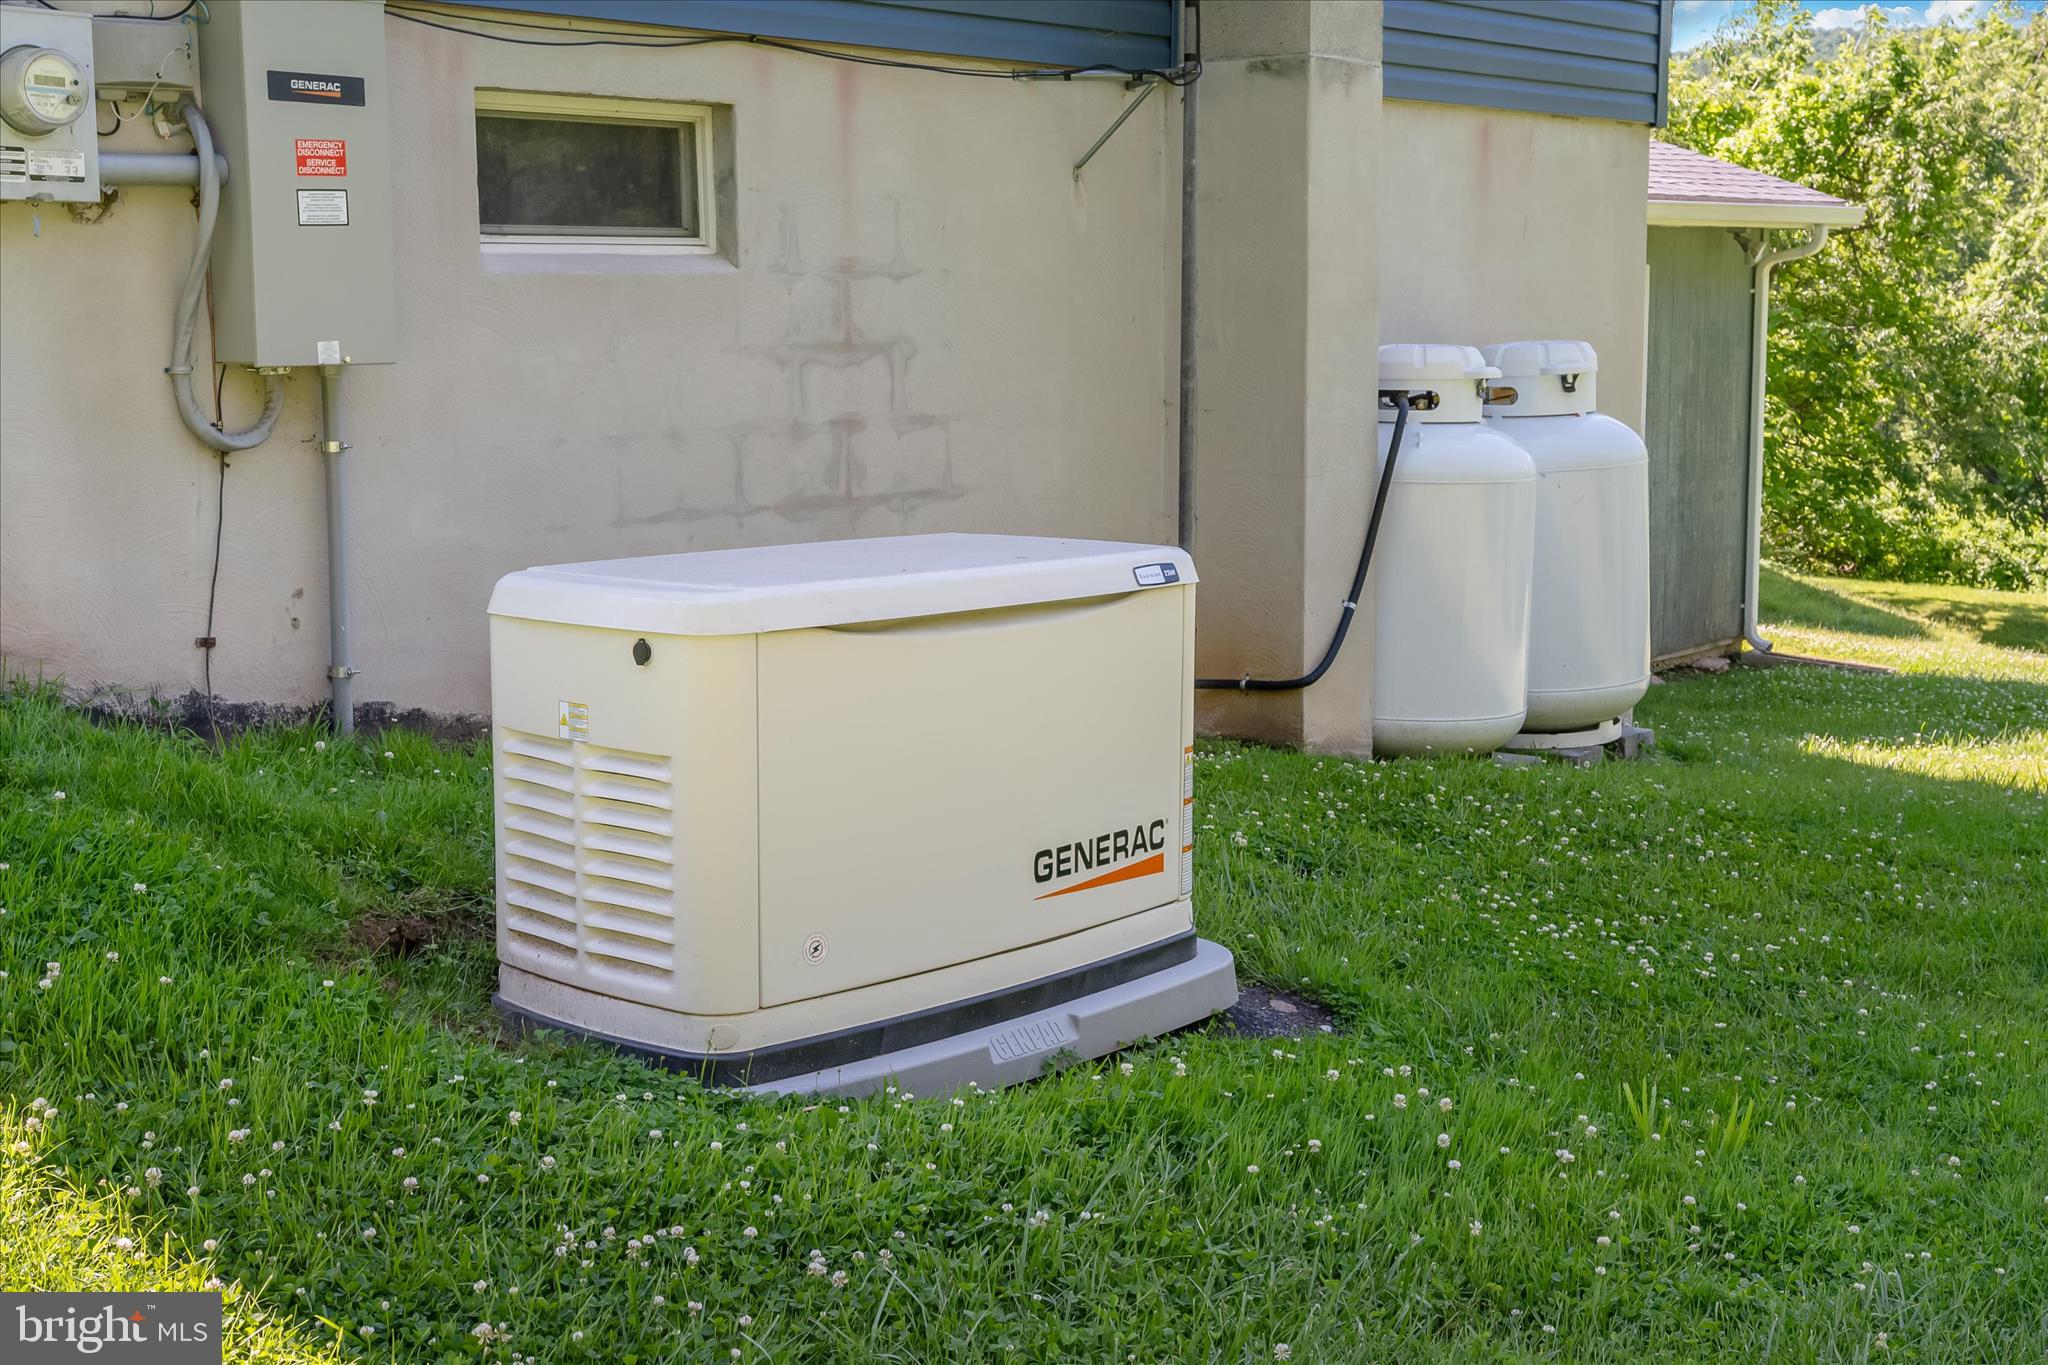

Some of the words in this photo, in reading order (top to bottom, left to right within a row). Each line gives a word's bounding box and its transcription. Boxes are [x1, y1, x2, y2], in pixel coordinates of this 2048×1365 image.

[290, 79, 341, 92] GENERAC
[297, 141, 343, 149] EMERGENCY
[306, 159, 337, 167] SERVICE
[1034, 819, 1165, 883] GENERAC
